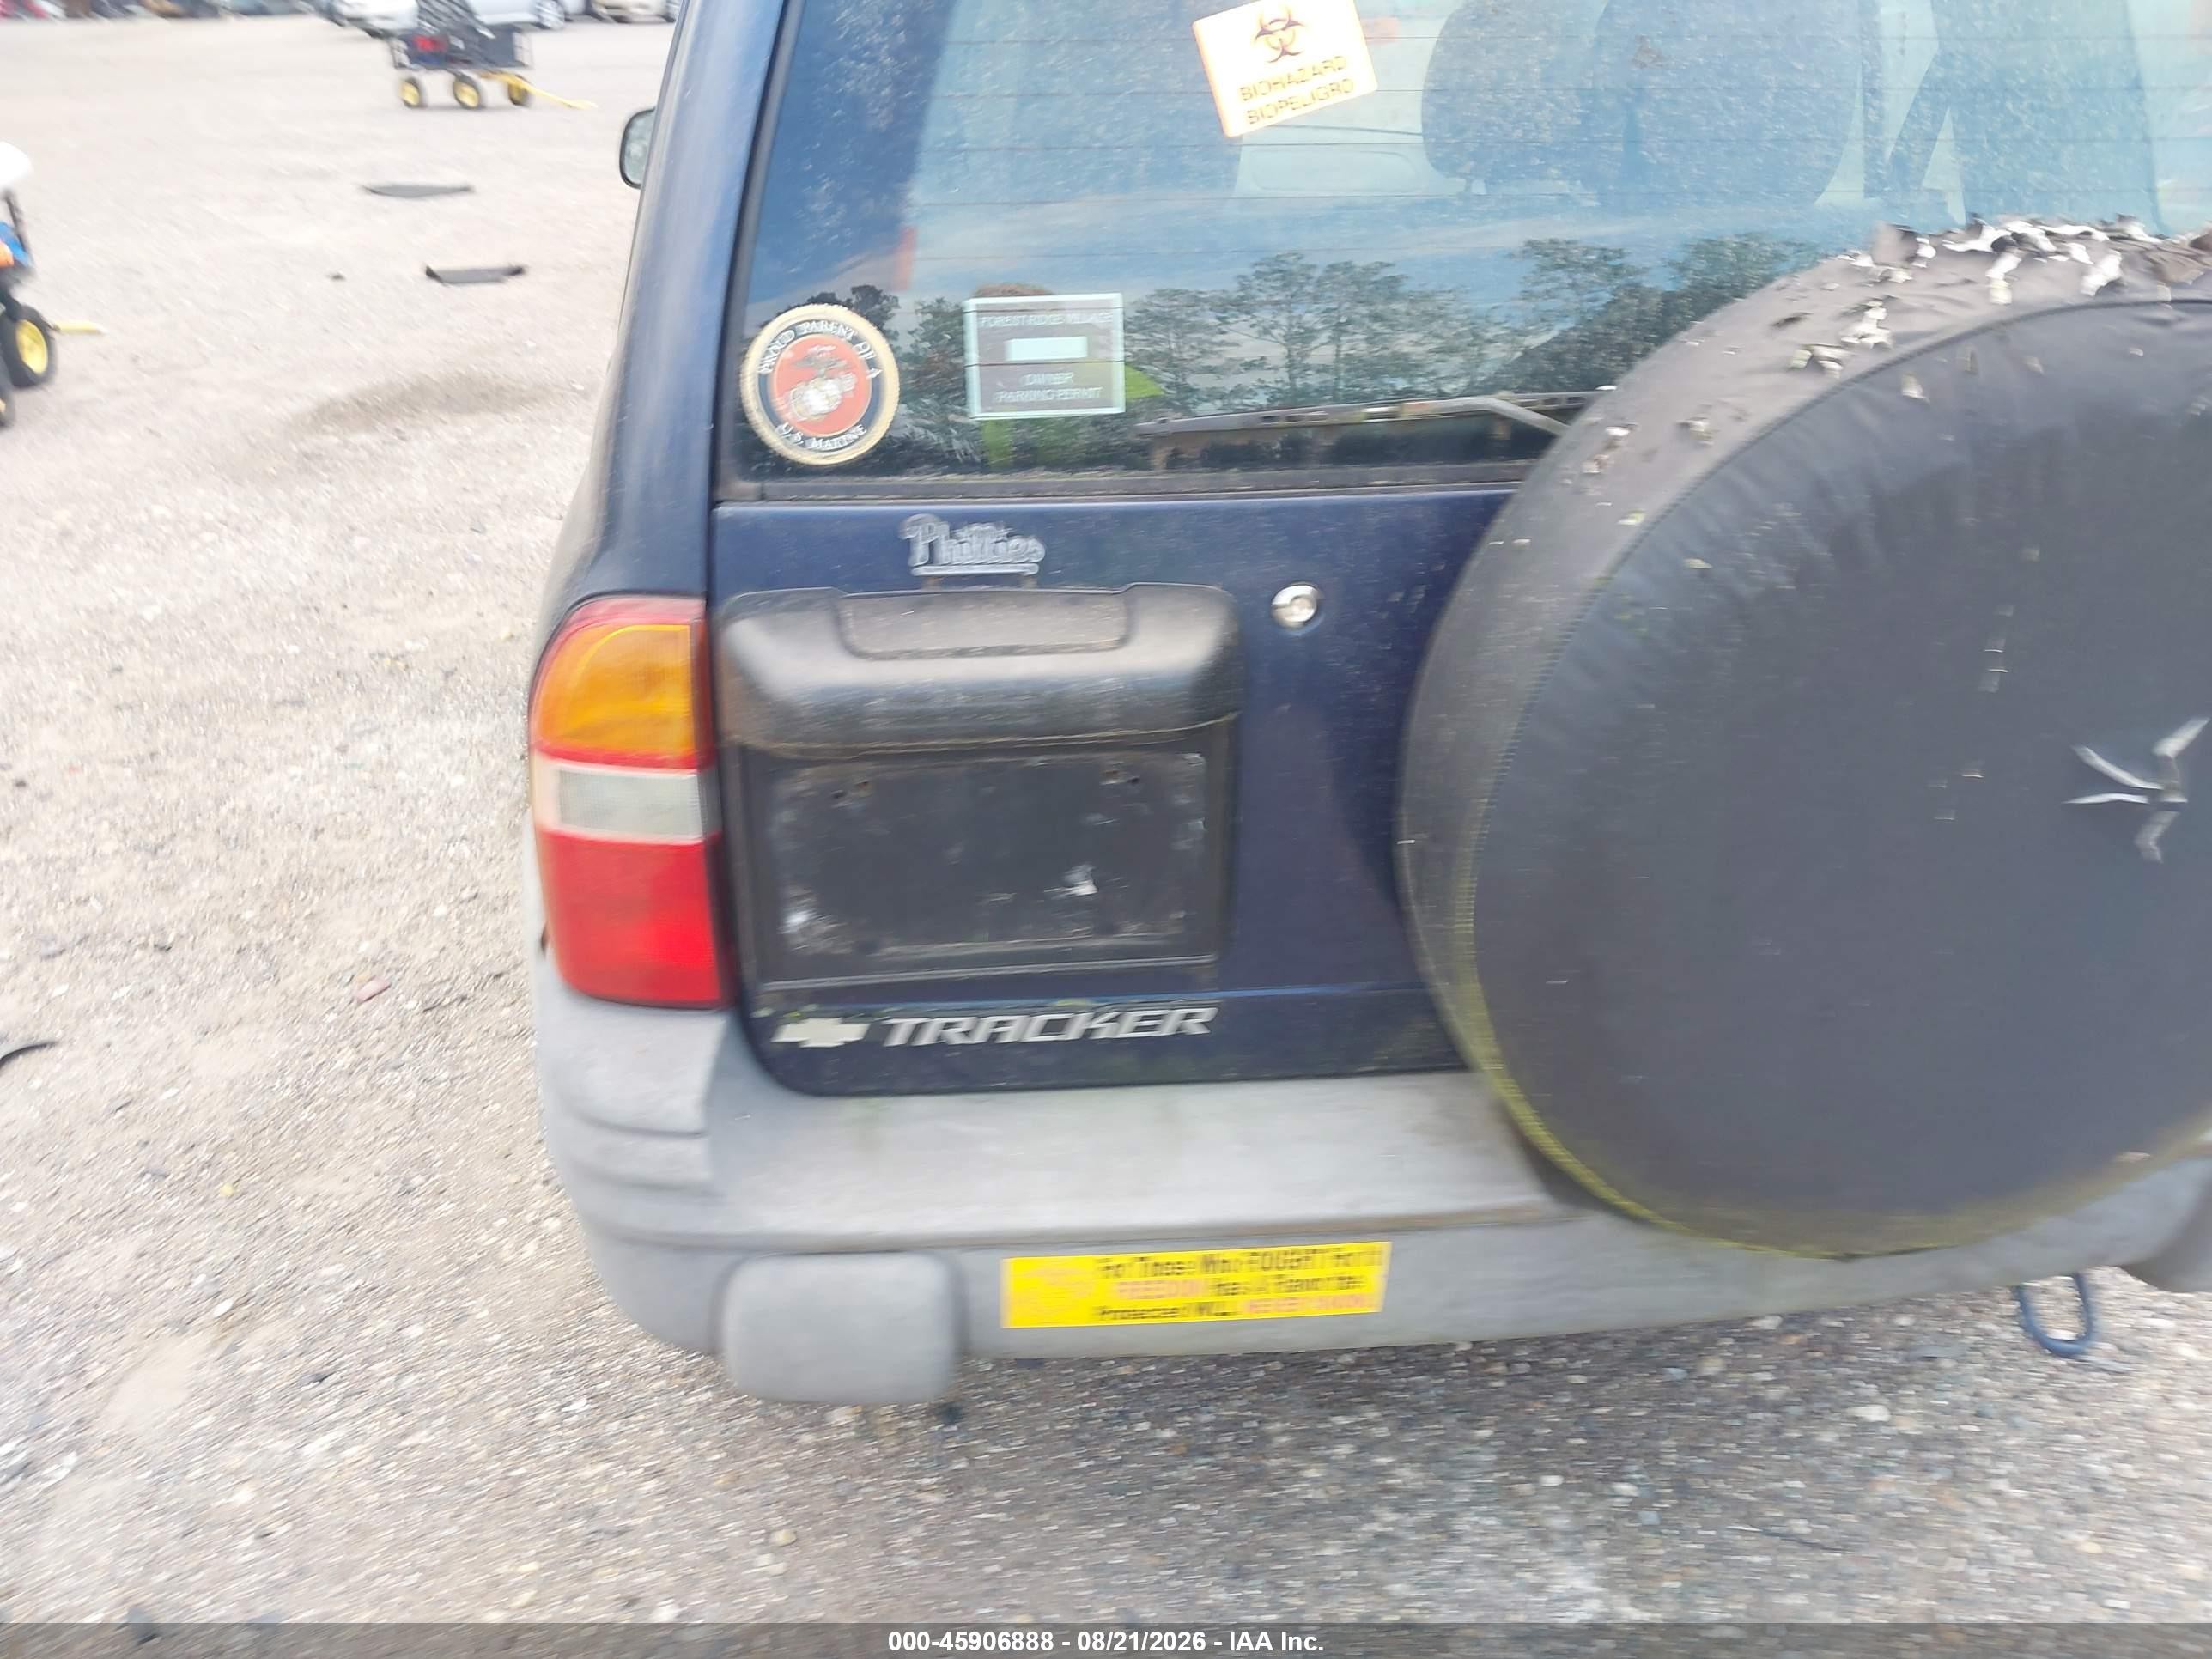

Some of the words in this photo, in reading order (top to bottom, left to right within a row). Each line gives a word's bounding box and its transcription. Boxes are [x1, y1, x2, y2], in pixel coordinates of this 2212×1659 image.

[1239, 56, 1347, 101] BIOHAZARD
[1247, 79, 1354, 125] BIOPELIGRO
[980, 314, 1025, 327] FOREST
[995, 389, 1054, 403] PARKING
[1056, 386, 1103, 400] PERMIT
[879, 1007, 1218, 1047] TRACKER
